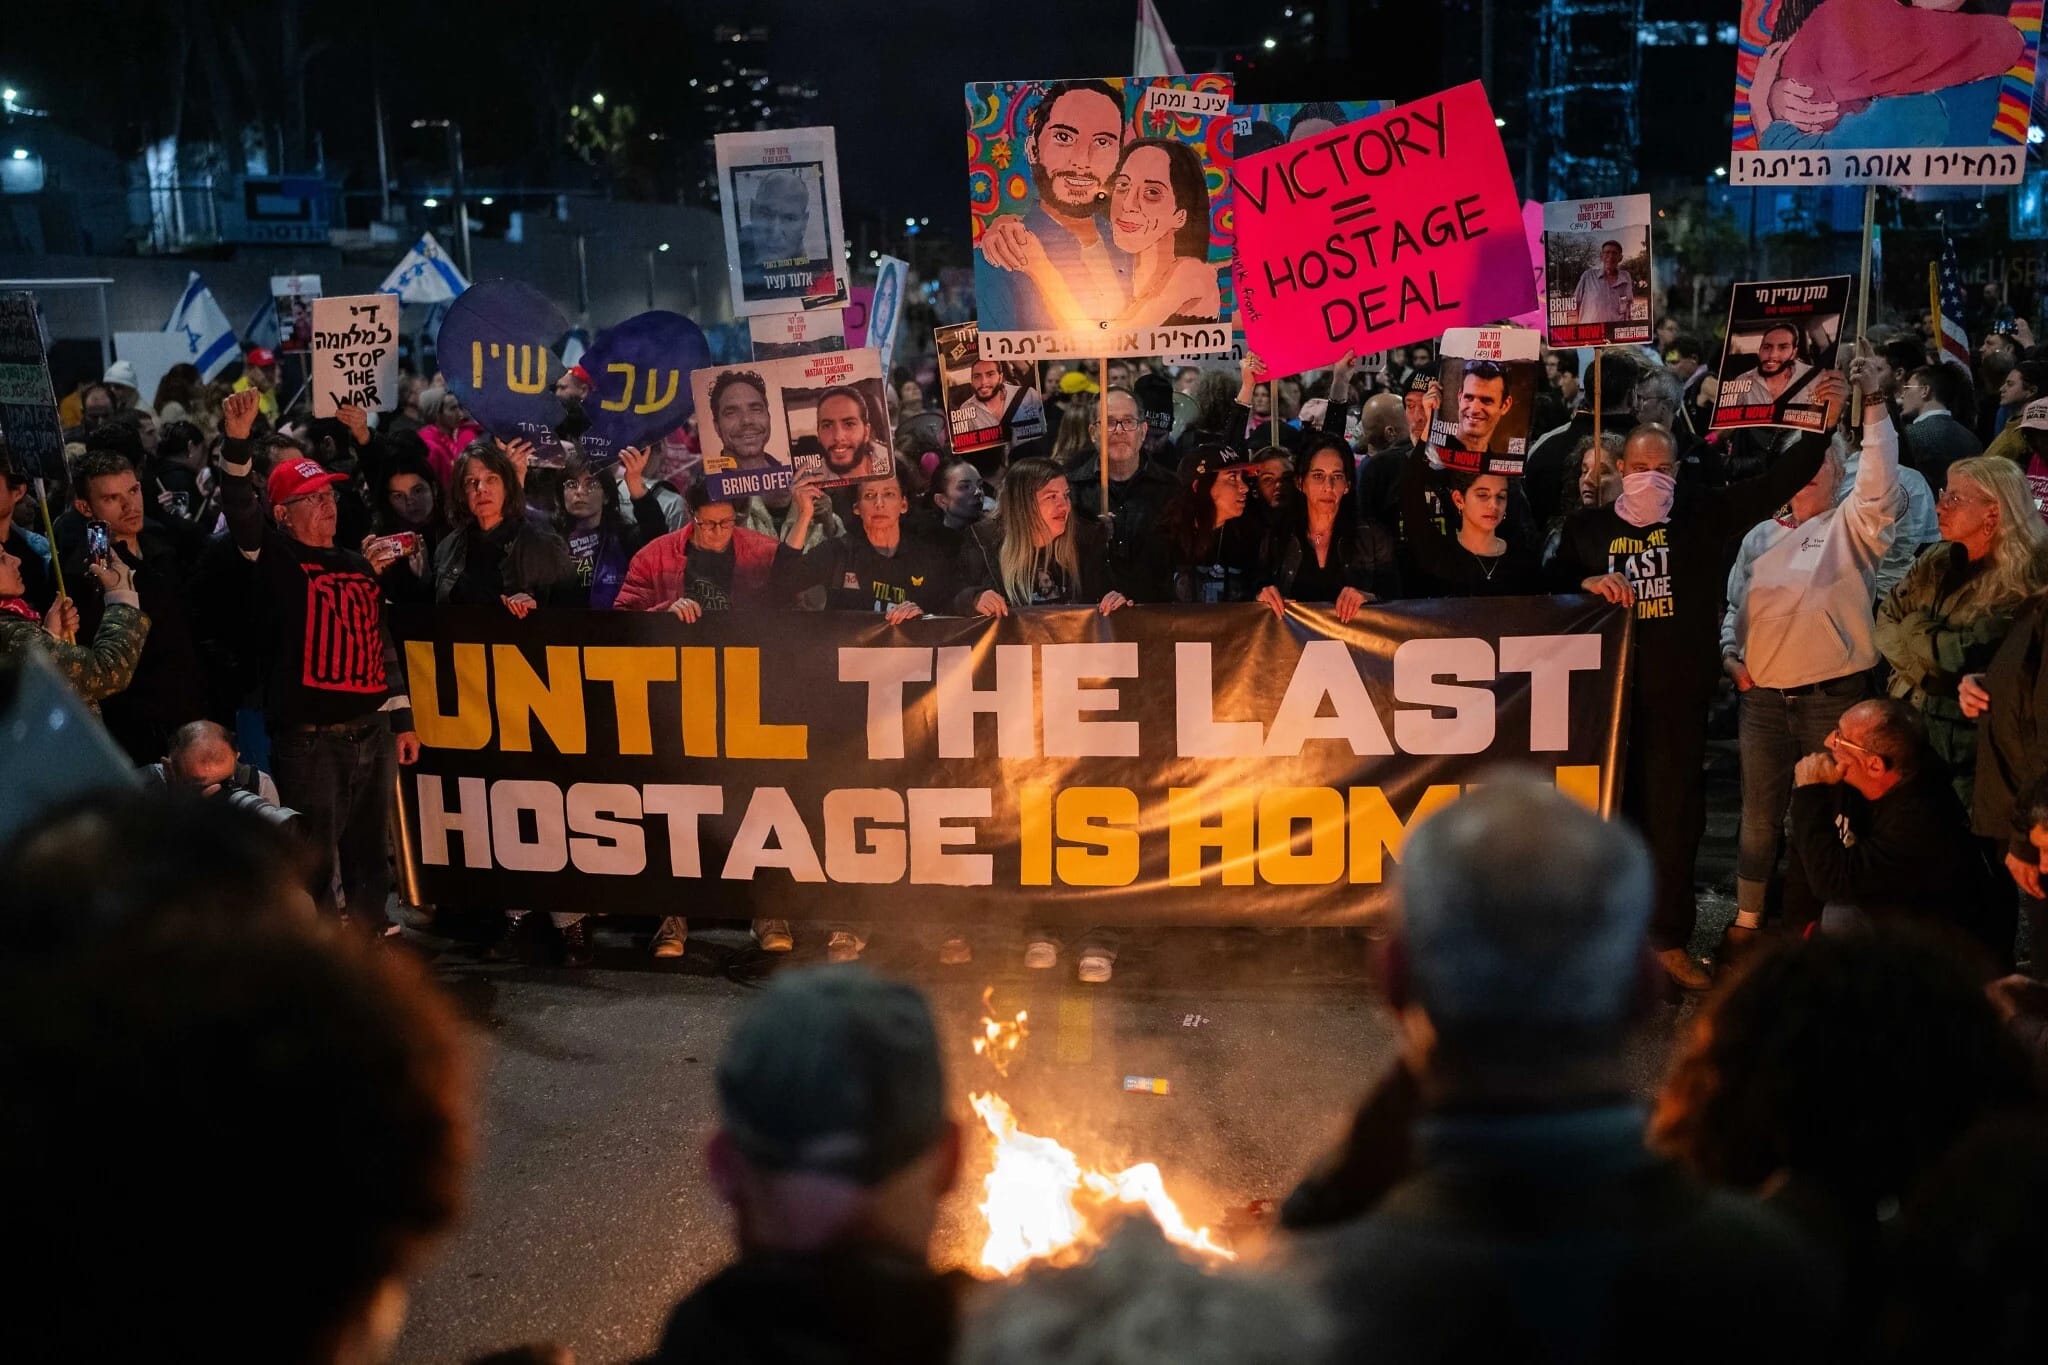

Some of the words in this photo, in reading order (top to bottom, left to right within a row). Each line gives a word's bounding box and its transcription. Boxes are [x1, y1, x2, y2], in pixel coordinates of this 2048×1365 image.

[1150, 91, 1186, 109] ומתן
[1192, 95, 1226, 111] עינב
[1234, 101, 1447, 214] VICTORY
[1845, 155, 1911, 177] אותה
[1924, 153, 2017, 177] החזירו
[1738, 156, 1831, 182] הביתה!
[1263, 193, 1489, 298] HOSTAGE
[763, 274, 787, 290] קציר
[787, 272, 813, 288] אלעד
[1755, 288, 1770, 303] חי
[1771, 287, 1802, 305] עדיין
[1803, 285, 1828, 304] מתן
[349, 304, 380, 324] די
[1321, 270, 1461, 342] DEAL
[1550, 297, 1577, 312] BRING
[1551, 311, 1568, 326] HIM
[314, 322, 392, 350] למלחמה
[1150, 328, 1226, 351] החזירו
[333, 348, 386, 369] STOP
[472, 341, 548, 394] שיו
[343, 368, 376, 386] THE
[600, 362, 679, 415] עכ
[1720, 379, 1752, 395] BRING
[328, 386, 382, 409] WAR
[1718, 393, 1739, 408] HIM
[950, 406, 977, 422] BRING
[1744, 405, 1775, 420] NOW!
[517, 421, 552, 434] ביחד
[952, 420, 970, 436] HIM
[1431, 420, 1458, 436] BRING
[1430, 431, 1447, 447] HIM
[721, 474, 760, 496] BRING
[1609, 535, 1646, 554] UNTIL
[1607, 547, 1671, 578] LAST
[1636, 597, 1674, 620] OME!
[404, 640, 808, 760] UNTIL
[838, 641, 1140, 760] THE
[1175, 633, 1602, 757] LAST
[417, 774, 994, 886] HOSTAGE
[1020, 786, 1140, 887] IS
